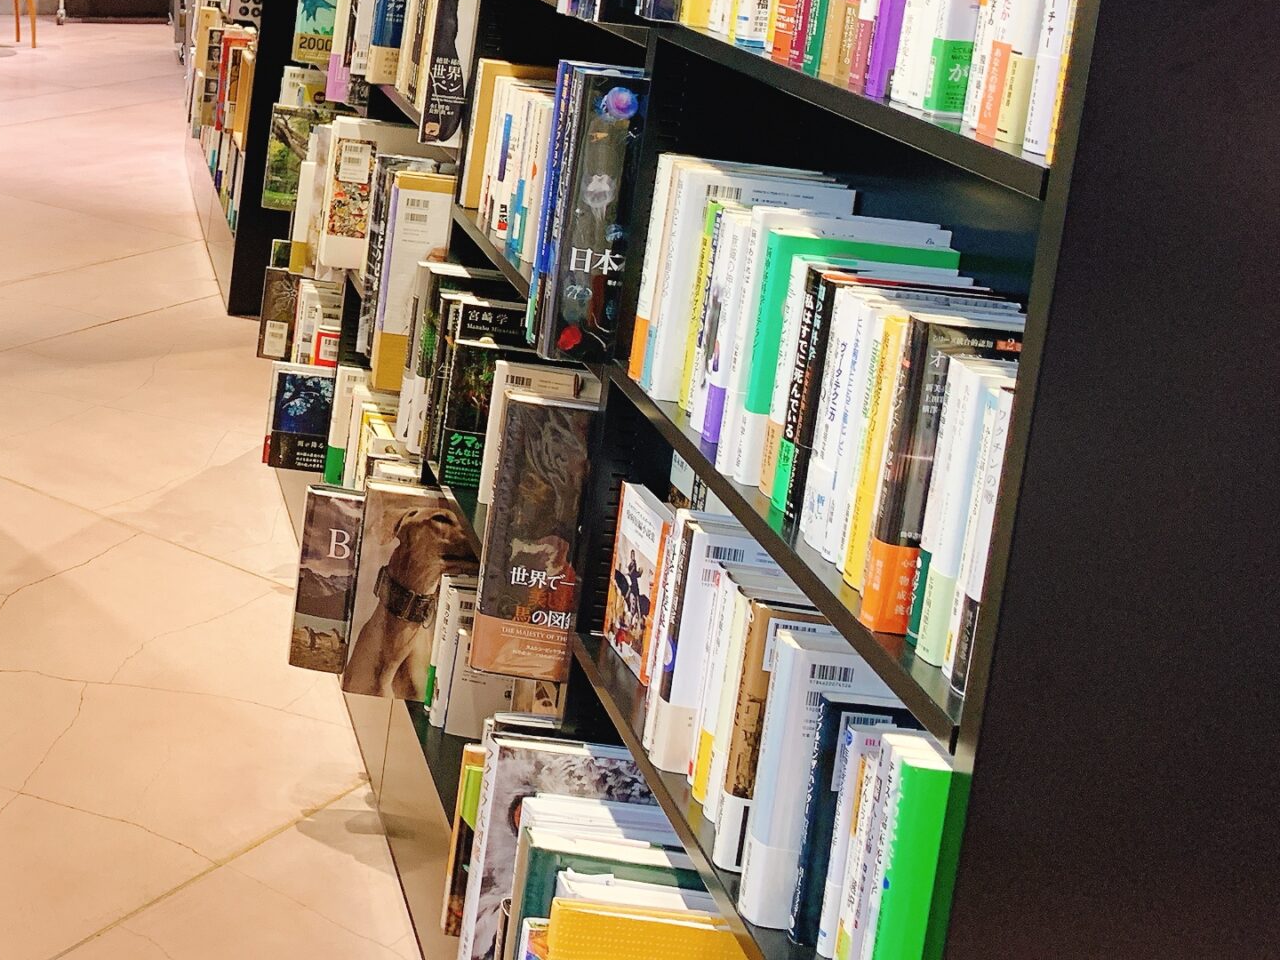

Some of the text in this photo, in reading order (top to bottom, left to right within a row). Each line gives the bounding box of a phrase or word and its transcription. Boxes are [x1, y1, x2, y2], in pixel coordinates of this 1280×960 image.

[432, 64, 462, 81] 世界
[569, 246, 620, 276] 日本
[785, 292, 816, 439] 私はすでに死んでいる
[447, 446, 481, 458] こんなに
[328, 528, 351, 560] B
[501, 626, 516, 634] THE
[516, 628, 545, 639] MAJESTY
[803, 701, 826, 816] インフルエンザ・ハンター
